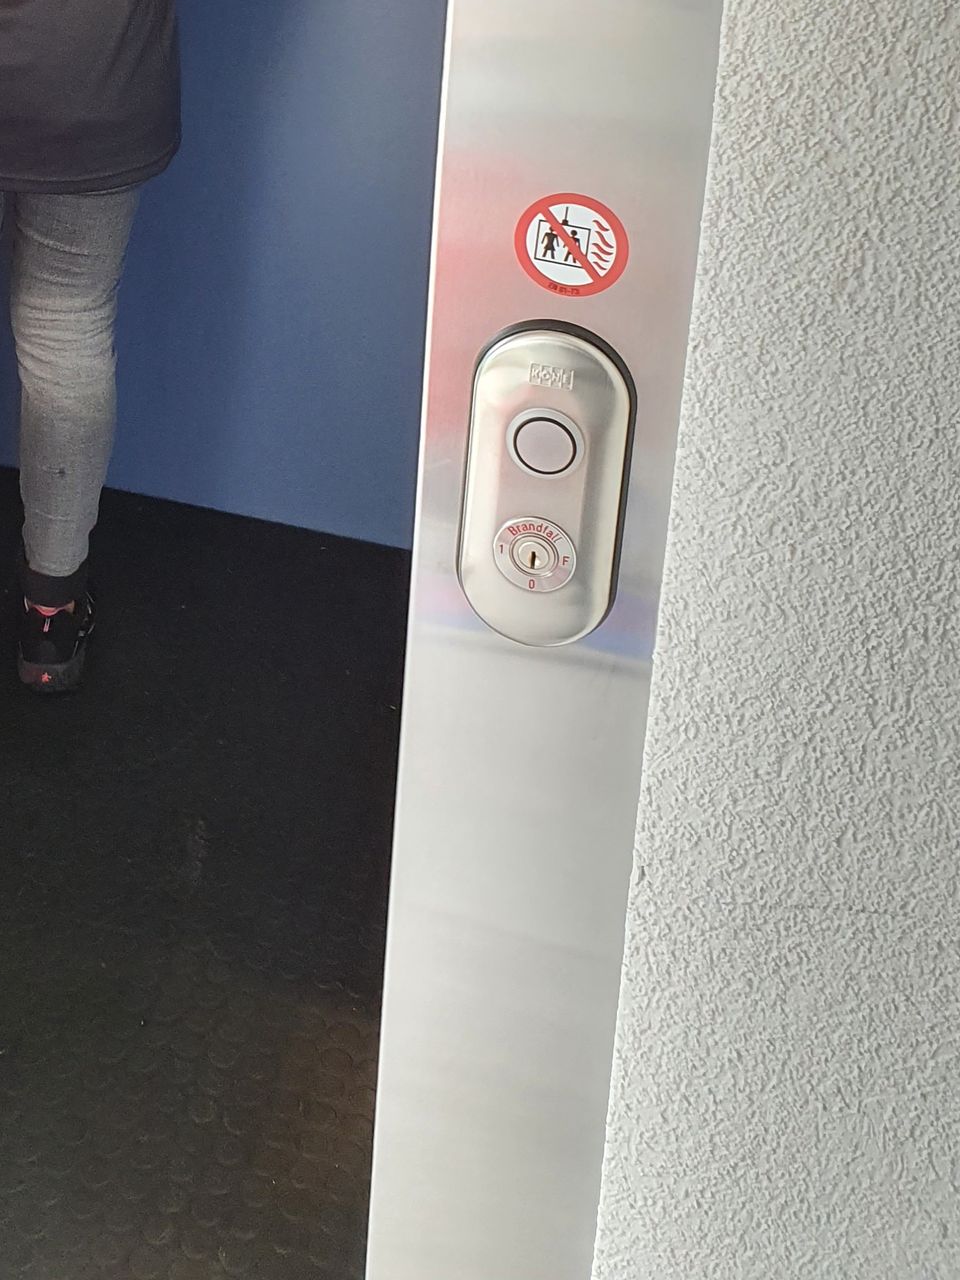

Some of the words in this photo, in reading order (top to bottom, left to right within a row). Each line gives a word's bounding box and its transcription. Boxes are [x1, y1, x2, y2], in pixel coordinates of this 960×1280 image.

[529, 364, 572, 387] KONE
[507, 523, 562, 543] Brandfall
[499, 544, 504, 554] 1
[562, 556, 570, 566] F
